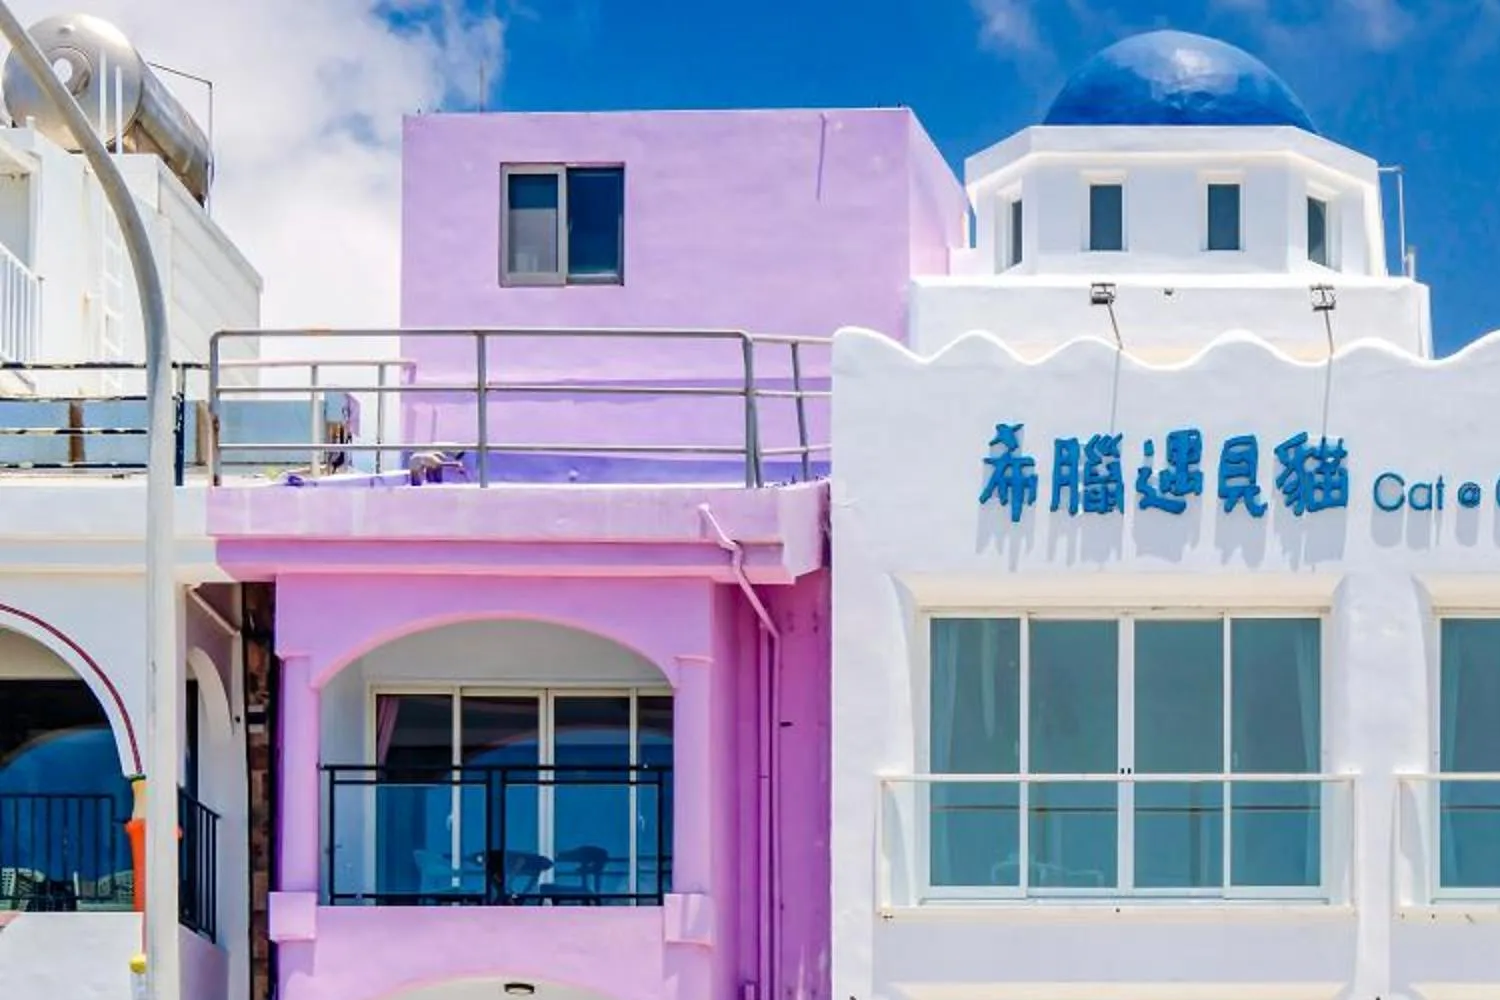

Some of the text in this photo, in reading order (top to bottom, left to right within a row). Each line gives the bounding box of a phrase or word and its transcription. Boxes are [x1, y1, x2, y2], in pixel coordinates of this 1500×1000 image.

[978, 423, 1350, 523] 希臘遇見貓
[1371, 471, 1446, 513] Cat
[1457, 481, 1483, 510] @
